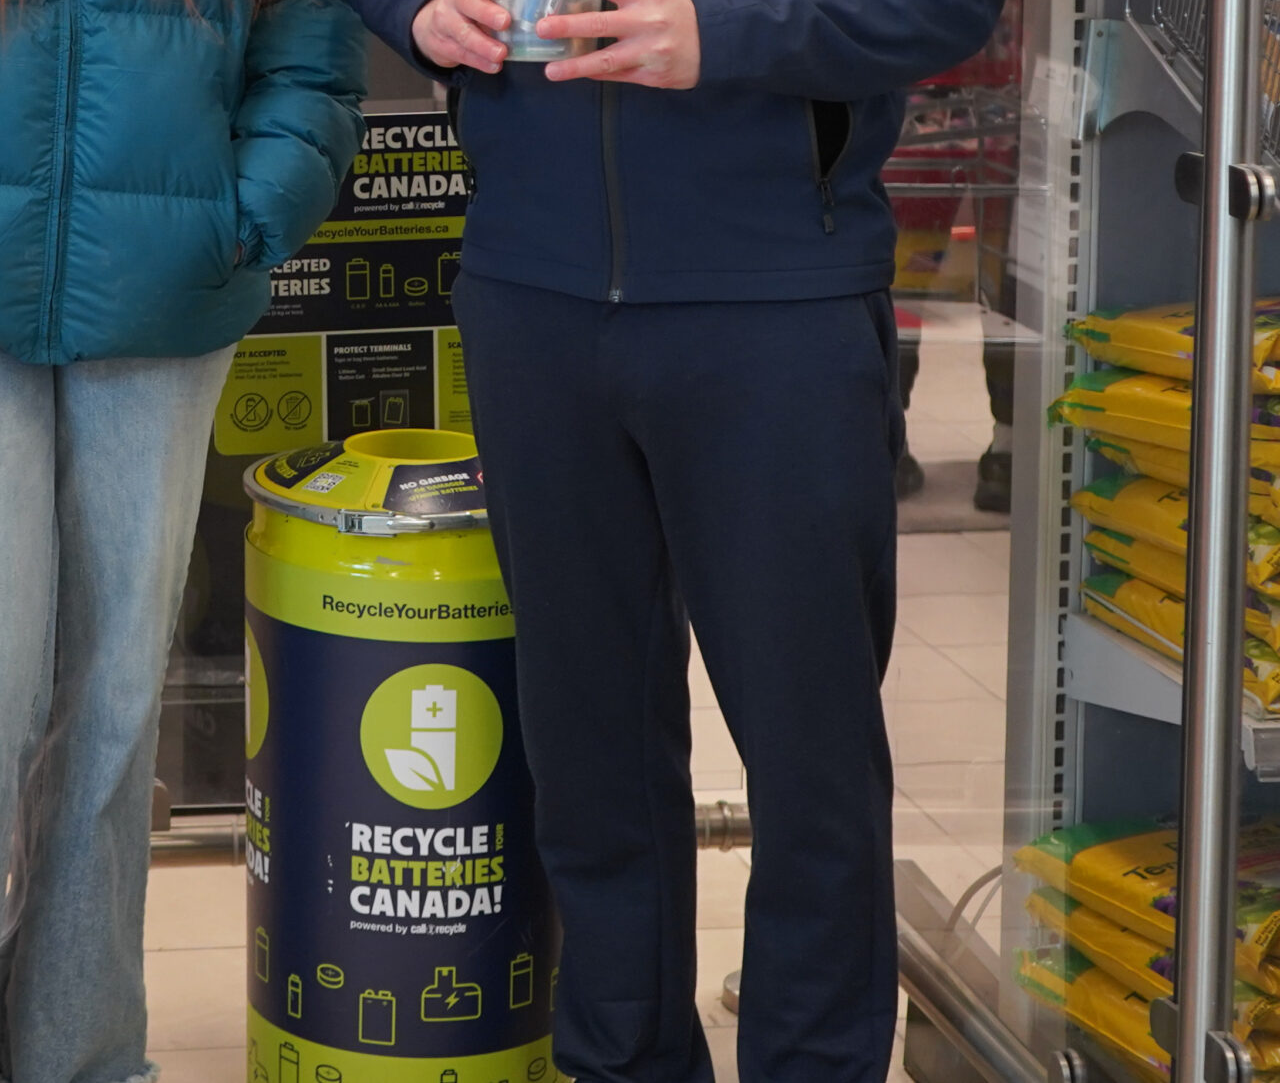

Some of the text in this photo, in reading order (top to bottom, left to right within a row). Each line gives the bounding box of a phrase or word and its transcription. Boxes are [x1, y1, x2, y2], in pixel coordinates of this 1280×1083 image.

[353, 151, 469, 174] BATTERIE
[354, 203, 389, 213] powered
[390, 203, 399, 213] by
[271, 278, 331, 297] TERIES
[249, 349, 287, 358] ACCEPTED
[334, 343, 412, 354] PROTECT TERMINALS
[399, 472, 470, 491] NO GARBAGE
[352, 822, 489, 856] RECYCLE
[495, 823, 504, 851] YOUR
[351, 855, 504, 887] BATTERIES
[350, 885, 503, 918] CANADA!
[350, 920, 394, 933] powered
[395, 923, 408, 935] by
